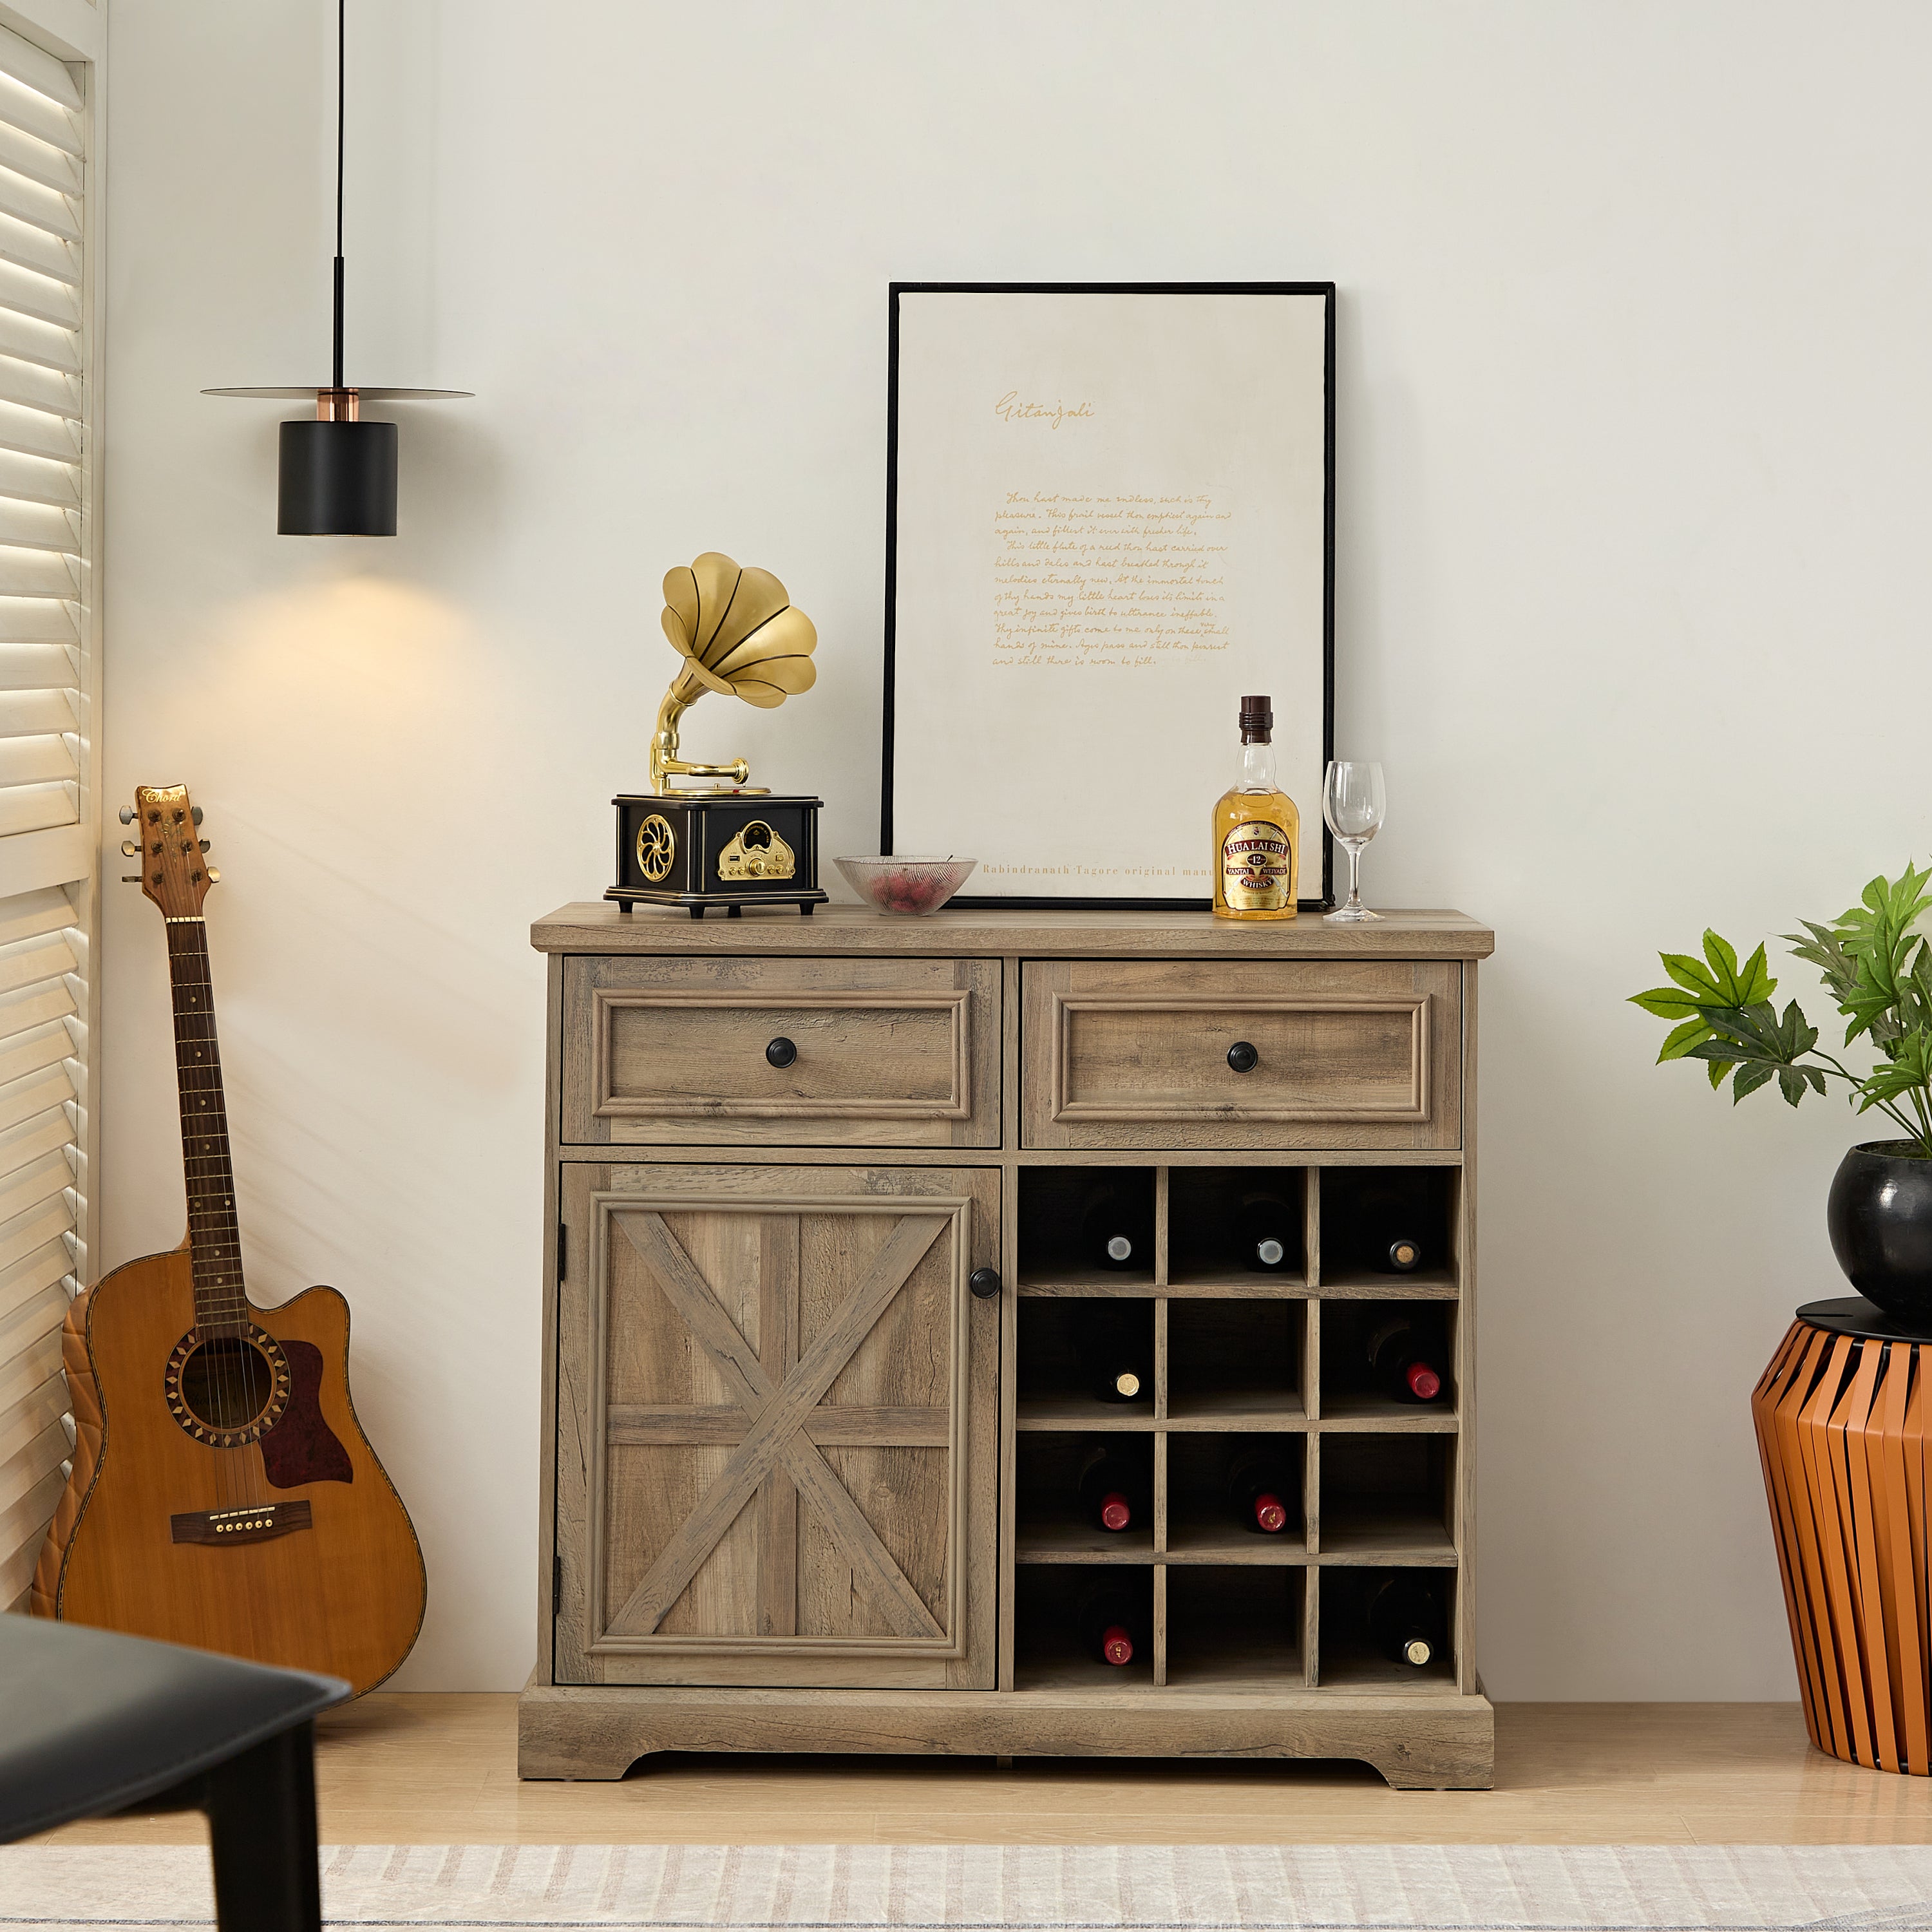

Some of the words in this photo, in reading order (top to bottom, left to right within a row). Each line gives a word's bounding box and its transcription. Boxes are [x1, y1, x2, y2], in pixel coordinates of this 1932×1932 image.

[995, 390, 1095, 430] Gitanjali
[1007, 492, 1029, 504] Thou
[1034, 491, 1059, 502] hast
[1116, 495, 1157, 504] endless,
[1160, 495, 1181, 504] such
[1184, 495, 1193, 503] is
[1196, 495, 1211, 509] thy
[1046, 508, 1066, 518] This
[1068, 508, 1094, 521] frail
[1097, 510, 1124, 518] vessel
[1127, 511, 1144, 519] thou
[1147, 511, 1186, 523] emptiest
[1186, 511, 1214, 526] again
[995, 526, 1028, 540] again,
[1053, 525, 1084, 537] fillest
[1087, 526, 1097, 534] it
[1121, 525, 1140, 534] with
[1142, 526, 1173, 538] fresher
[1177, 524, 1197, 536] life.
[1007, 541, 1025, 550] This
[1030, 540, 1050, 550] little
[1052, 541, 1077, 553] flute
[1079, 544, 1088, 556] of
[1146, 542, 1168, 552] hast
[994, 556, 1019, 567] hills
[1045, 558, 1068, 567] dales
[1095, 557, 1119, 567] hast
[994, 574, 1037, 583] melodies
[1041, 573, 1086, 591] eternally
[1114, 573, 1129, 583] At
[1131, 575, 1144, 584] the
[1147, 575, 1193, 585] immortal
[994, 592, 1002, 606] of
[1005, 591, 1019, 606] thy
[1024, 589, 1054, 600] hands
[1058, 594, 1073, 607] my
[1079, 591, 1104, 600] little
[1108, 589, 1137, 600] heart
[1139, 591, 1159, 600] loses
[1162, 591, 1173, 601] its
[1175, 591, 1204, 601] limits
[1206, 592, 1217, 601] in
[994, 607, 1022, 620] great
[1023, 609, 1037, 622] joy
[1060, 609, 1082, 620] gives
[1084, 606, 1106, 616] birth
[1109, 607, 1117, 616] to
[1121, 608, 1166, 618] utterance
[1170, 607, 1217, 621] ineffable.
[995, 623, 1012, 639] Thy
[1015, 623, 1059, 635] infinite
[1060, 625, 1081, 638] gifts
[1144, 624, 1163, 639] only
[1178, 626, 1200, 634] these
[1204, 627, 1229, 635] small
[994, 637, 1025, 649] hands
[1028, 641, 1036, 654] of
[1041, 640, 1072, 649] mine.
[1075, 638, 1099, 655] Ages
[1150, 640, 1170, 649] still
[1172, 641, 1189, 649] thou
[992, 657, 1014, 665] and
[1018, 655, 1042, 665] still
[1046, 656, 1072, 665] there
[1075, 656, 1084, 665] is
[1122, 656, 1130, 665] to
[1135, 656, 1156, 668] fill.
[142, 789, 182, 803] Chord
[1253, 855, 1261, 864] 12
[983, 864, 1069, 875] Rabindranath
[1075, 864, 1118, 876] Tagore
[1124, 865, 1175, 877] original
[1243, 877, 1272, 888] WHISKY
